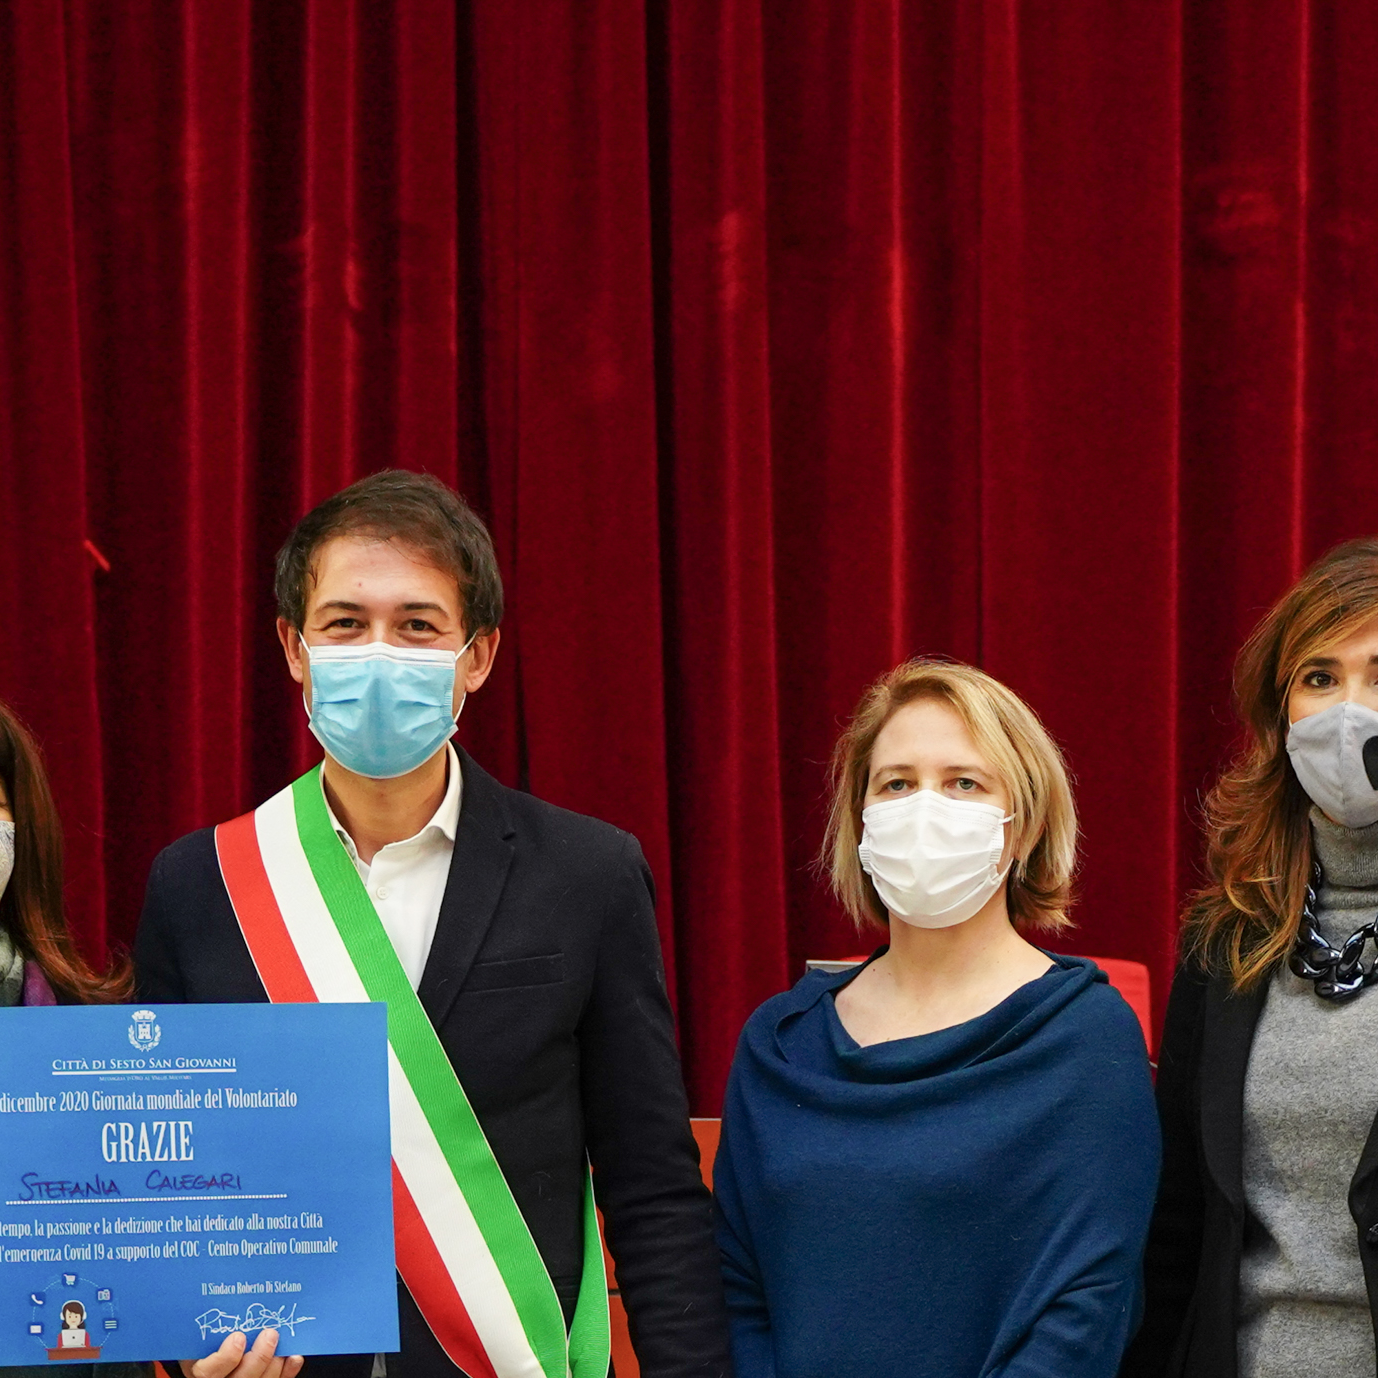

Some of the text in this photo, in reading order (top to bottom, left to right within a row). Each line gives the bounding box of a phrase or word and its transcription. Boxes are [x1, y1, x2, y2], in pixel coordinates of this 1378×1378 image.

[59, 1090, 90, 1112] 2020
[91, 1090, 145, 1111] Giornata
[146, 1089, 202, 1110] mondiale
[204, 1087, 223, 1109] del
[224, 1087, 298, 1109] Volontariato
[101, 1120, 194, 1163] GRAZIE
[34, 1219, 45, 1237] la
[46, 1218, 92, 1239] passione
[93, 1221, 101, 1235] e
[101, 1217, 113, 1235] la
[114, 1216, 164, 1234] dedizione
[165, 1215, 184, 1233] che
[185, 1214, 202, 1233] hai
[203, 1214, 245, 1232] dedicato
[246, 1212, 265, 1231] alla
[266, 1214, 299, 1230] nostra
[300, 1211, 324, 1229] Città
[63, 1243, 92, 1261] Covid
[93, 1242, 105, 1260] 19
[106, 1247, 115, 1260] a
[115, 1243, 161, 1263] supporto
[162, 1240, 179, 1259] del
[180, 1240, 200, 1258] COC
[207, 1239, 240, 1257] Centro
[240, 1238, 288, 1259] Operativo
[289, 1236, 339, 1255] Comunale
[207, 1282, 236, 1295] Sindaco
[236, 1281, 265, 1295] Roberto
[274, 1280, 302, 1294] Stefano
